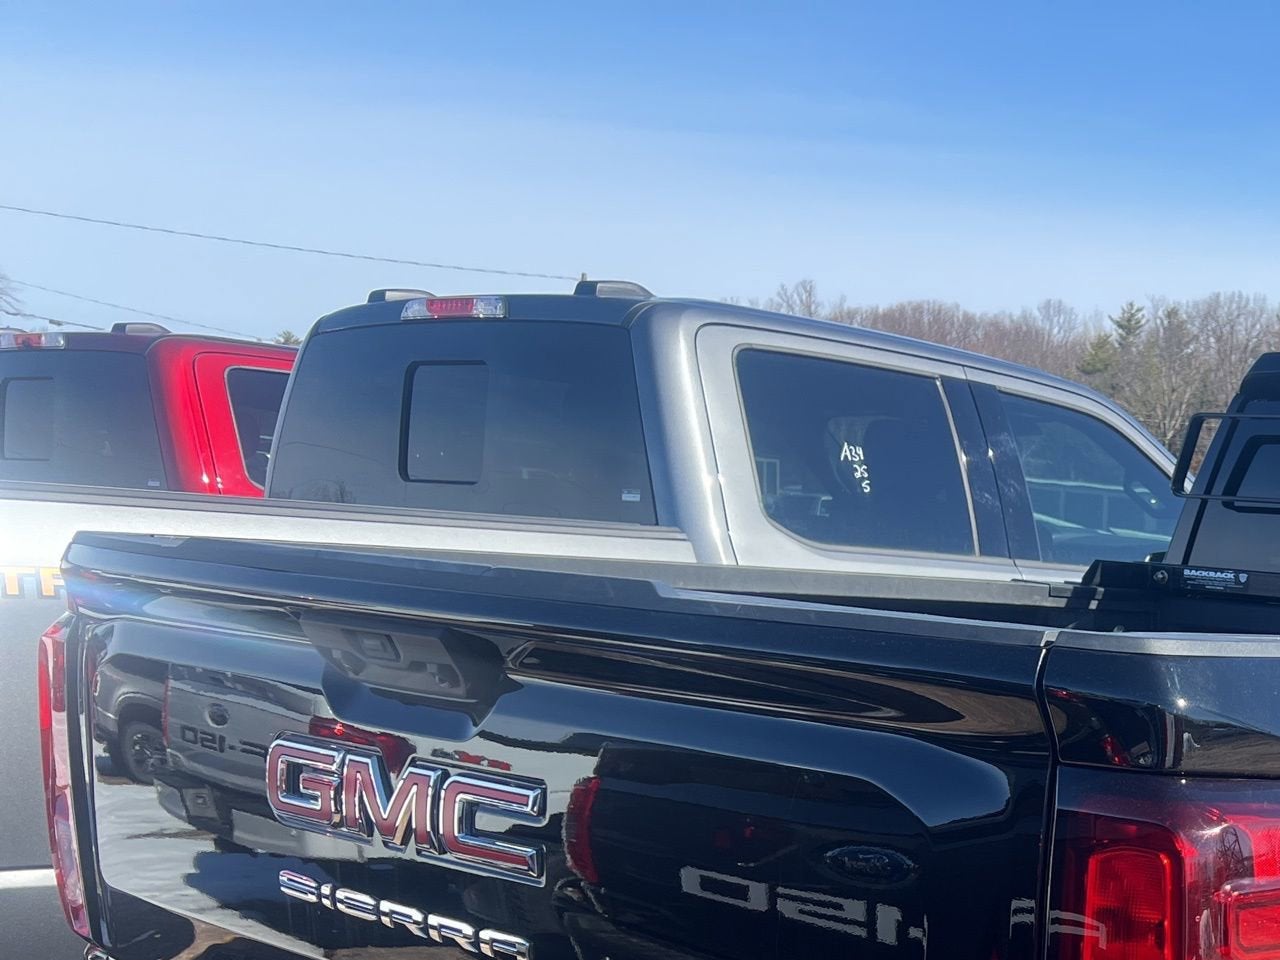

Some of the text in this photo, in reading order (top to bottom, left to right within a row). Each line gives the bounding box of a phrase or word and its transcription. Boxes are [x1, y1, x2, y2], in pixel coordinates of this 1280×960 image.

[840, 441, 864, 461] A34
[853, 464, 868, 478] 25
[1183, 568, 1236, 579] BACKRACK
[265, 732, 547, 885] GMC
